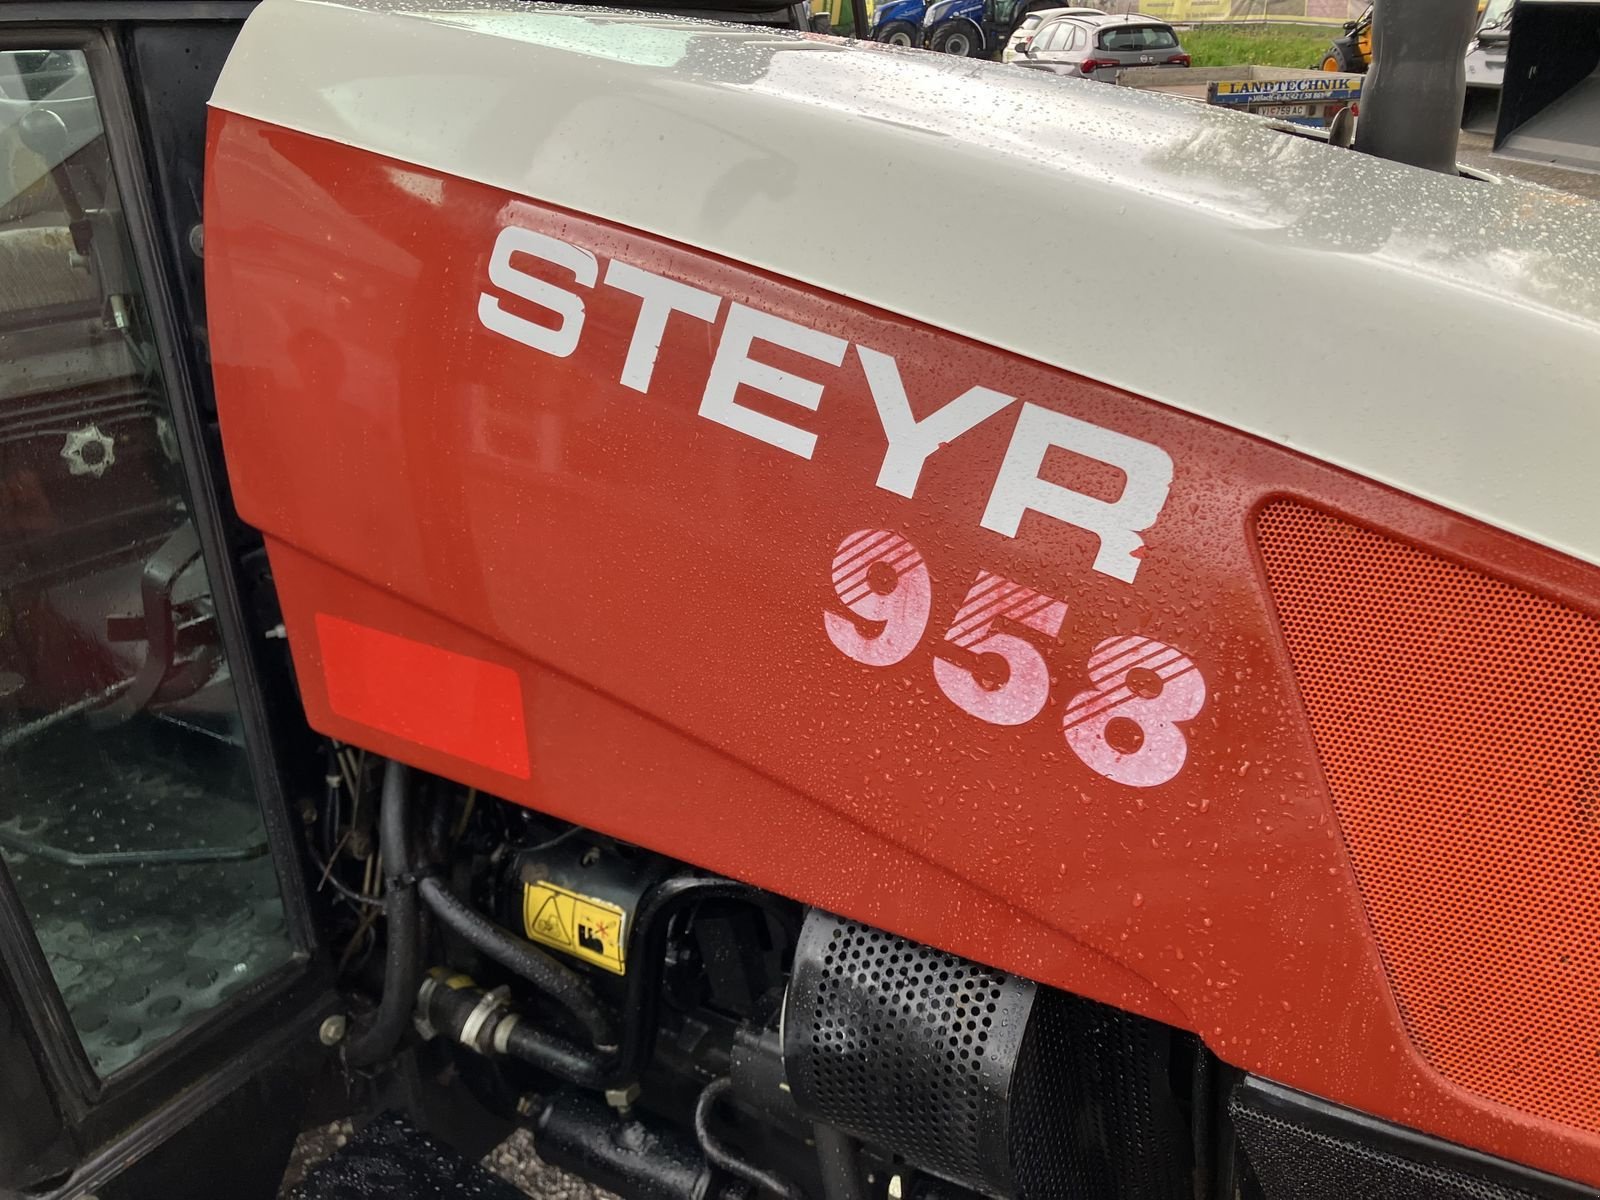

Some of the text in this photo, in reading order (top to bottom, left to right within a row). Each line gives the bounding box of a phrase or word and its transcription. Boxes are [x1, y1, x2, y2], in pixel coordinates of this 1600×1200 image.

[1230, 79, 1350, 93] LANDTECHNIK
[477, 225, 1174, 584] STEYR
[823, 528, 1207, 787] 958
